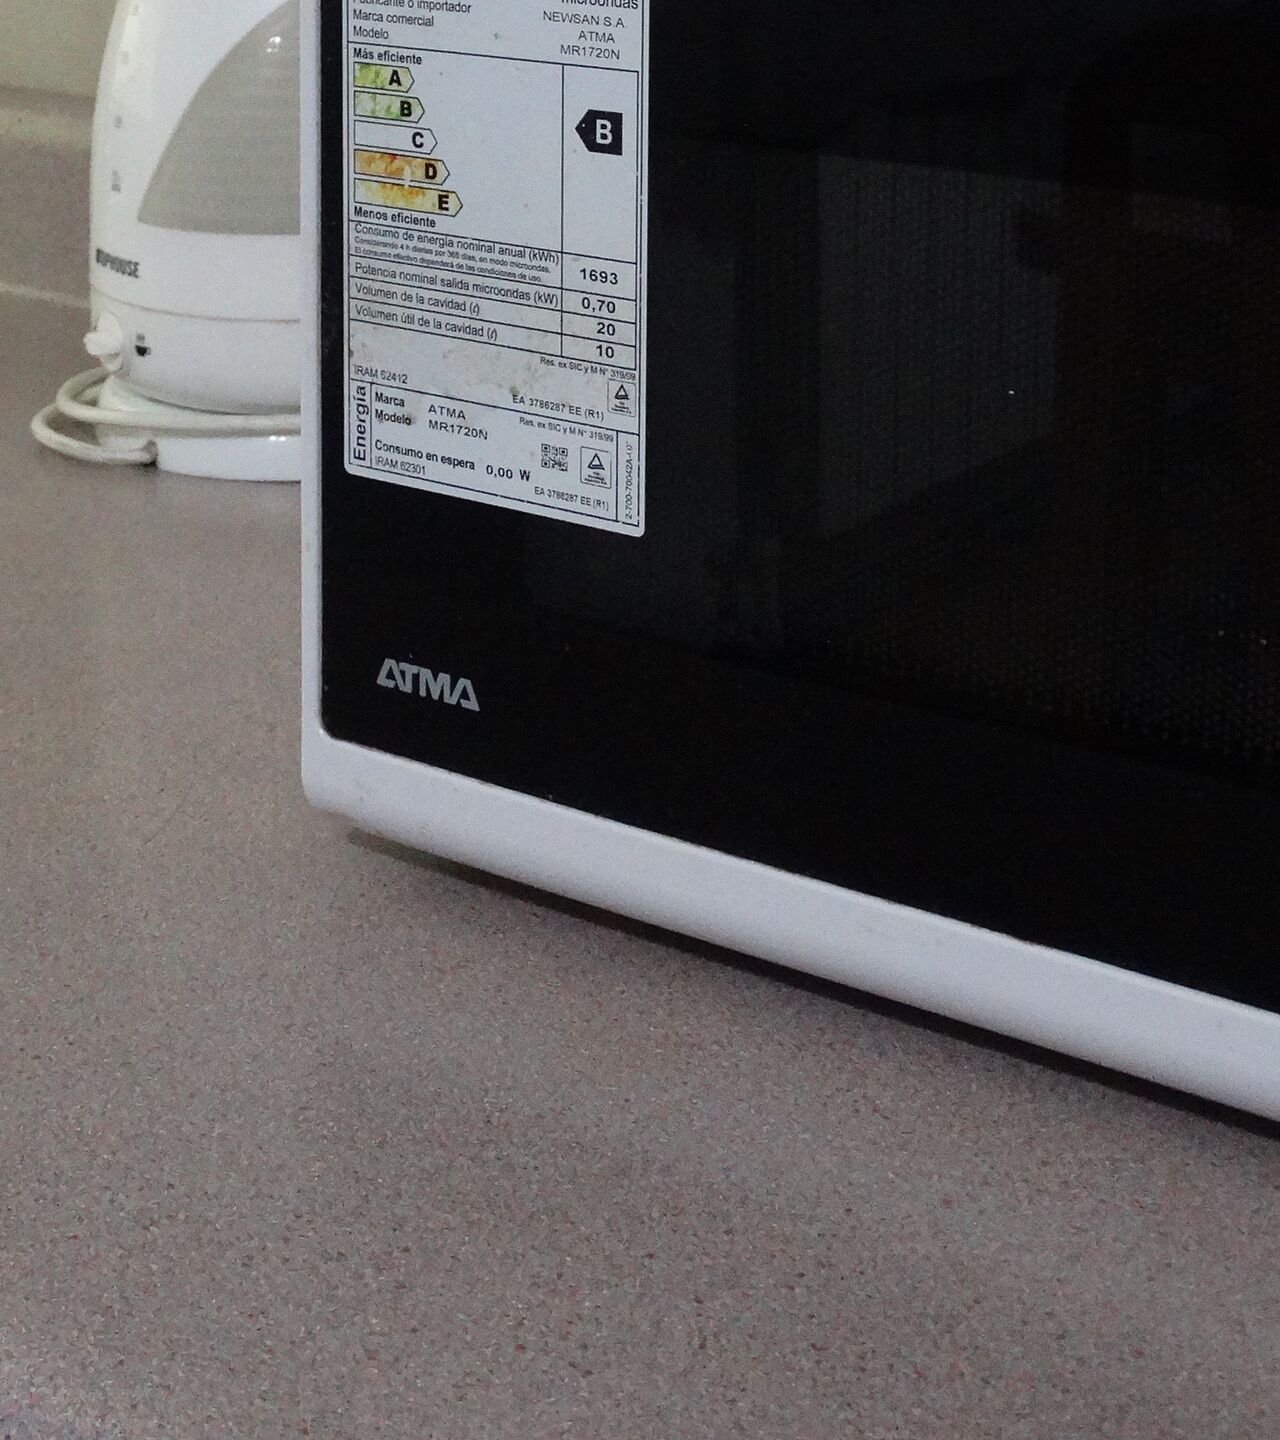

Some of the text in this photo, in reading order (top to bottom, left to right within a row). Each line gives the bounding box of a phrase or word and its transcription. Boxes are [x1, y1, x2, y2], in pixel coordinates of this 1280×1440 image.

[408, 0, 415, 9] o
[353, 9, 435, 27] Marca comercial
[543, 10, 600, 26] NEWSAN
[353, 26, 389, 40] Modelo
[578, 30, 616, 44] ATMA
[353, 47, 423, 66] Más eficiente
[560, 44, 620, 60] MR1720N
[388, 69, 403, 87] A
[399, 101, 413, 118] B
[411, 132, 425, 149] C
[594, 119, 613, 145] B
[424, 163, 438, 180] D
[437, 194, 450, 212] E
[353, 206, 436, 229] Menos eficiente
[354, 222, 400, 240] Consumo
[402, 231, 415, 241] de
[457, 240, 496, 254] nominal
[498, 247, 526, 259] anual
[528, 248, 559, 266] (kWh)
[489, 256, 508, 267] modo
[354, 261, 559, 308] Potencia nominal salida microondas (kW)
[579, 267, 619, 286] 1693
[355, 282, 398, 300] Volumen
[400, 290, 413, 303] de
[416, 292, 425, 305] la
[427, 296, 467, 312] cavidad
[581, 296, 616, 314] 0,70
[355, 303, 398, 321] Volumen
[401, 310, 415, 325] útil
[417, 315, 431, 328] de
[433, 318, 442, 330] la
[444, 321, 484, 337] cavidad
[597, 321, 616, 337] 20
[595, 343, 615, 359] 10
[583, 365, 590, 375] y
[374, 391, 466, 421] Marca ATMA
[512, 394, 526, 405] EA
[568, 405, 582, 417] EE
[584, 408, 605, 423] (R1)
[353, 385, 370, 462] Energía
[374, 408, 488, 441] Modelo MR1720N
[563, 425, 569, 435] y
[569, 425, 577, 434] M
[374, 439, 424, 460] Consumo
[425, 451, 439, 463] en
[440, 454, 476, 471] espera
[519, 469, 531, 482] W
[400, 460, 427, 476] 62301
[534, 486, 546, 496] EA
[580, 496, 592, 507] EE
[593, 497, 610, 512] (R1)
[376, 658, 480, 712] ATMA
